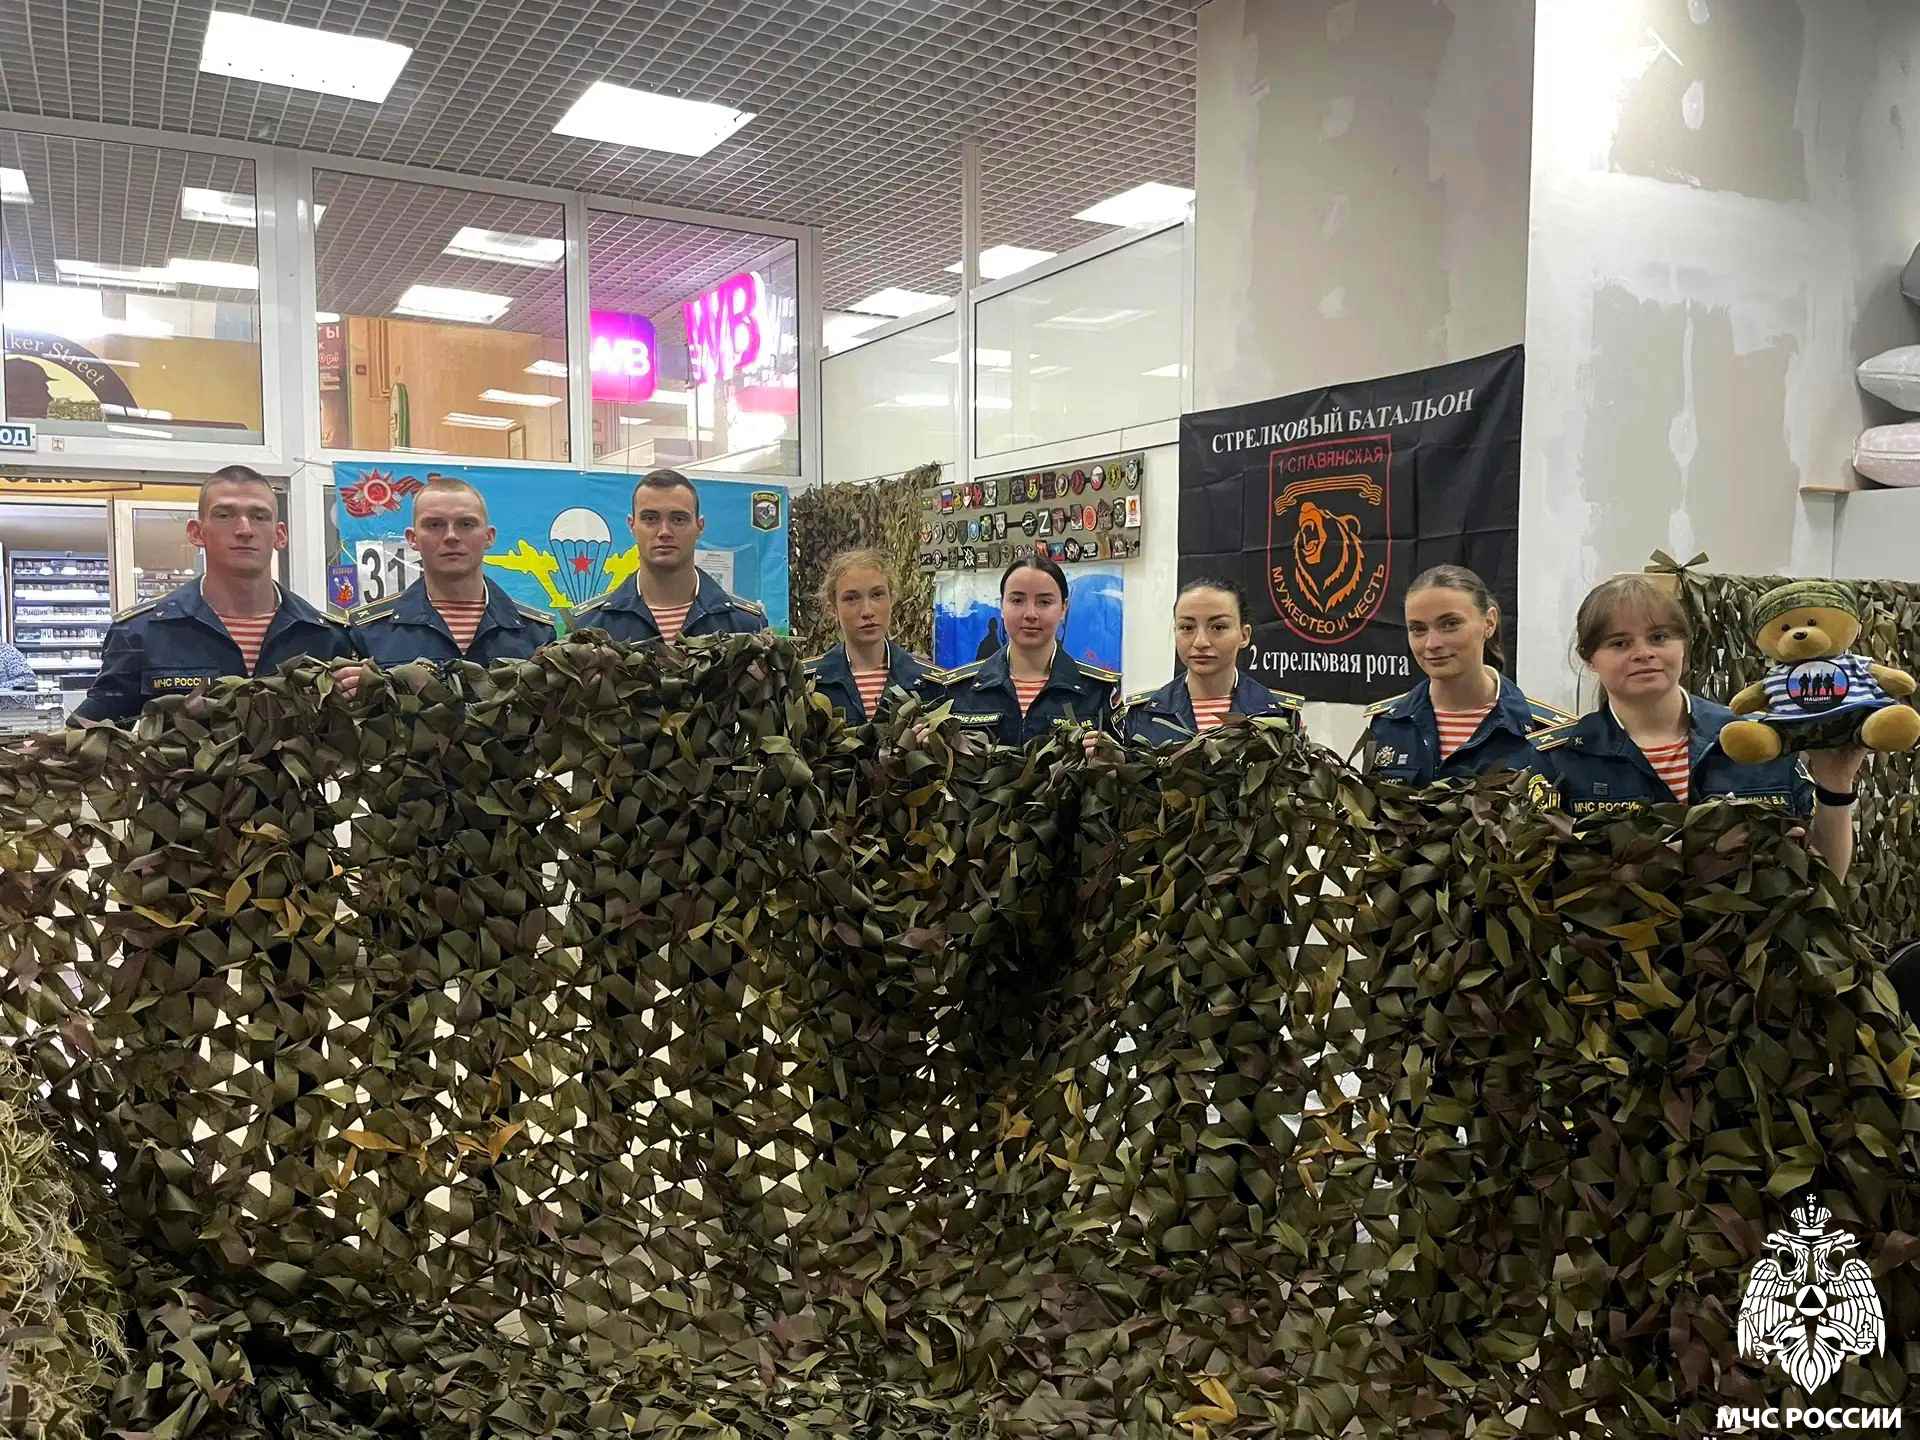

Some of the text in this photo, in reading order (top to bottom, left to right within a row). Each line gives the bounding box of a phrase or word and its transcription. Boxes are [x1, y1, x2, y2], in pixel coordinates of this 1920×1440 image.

[49, 343, 105, 387] Street
[1211, 388, 1476, 454] СТРЕЛКОВЫЙ БАТАЛЬОН
[1287, 446, 1384, 473] СЛАВЯНСКАЯ
[1038, 511, 1051, 535] Z
[361, 547, 405, 603] 31
[1337, 616, 1349, 632] И
[1347, 563, 1385, 619] ЧЕСТЬ
[1248, 644, 1411, 683] 2 стрелковая рота
[1574, 802, 1595, 813] МЧС
